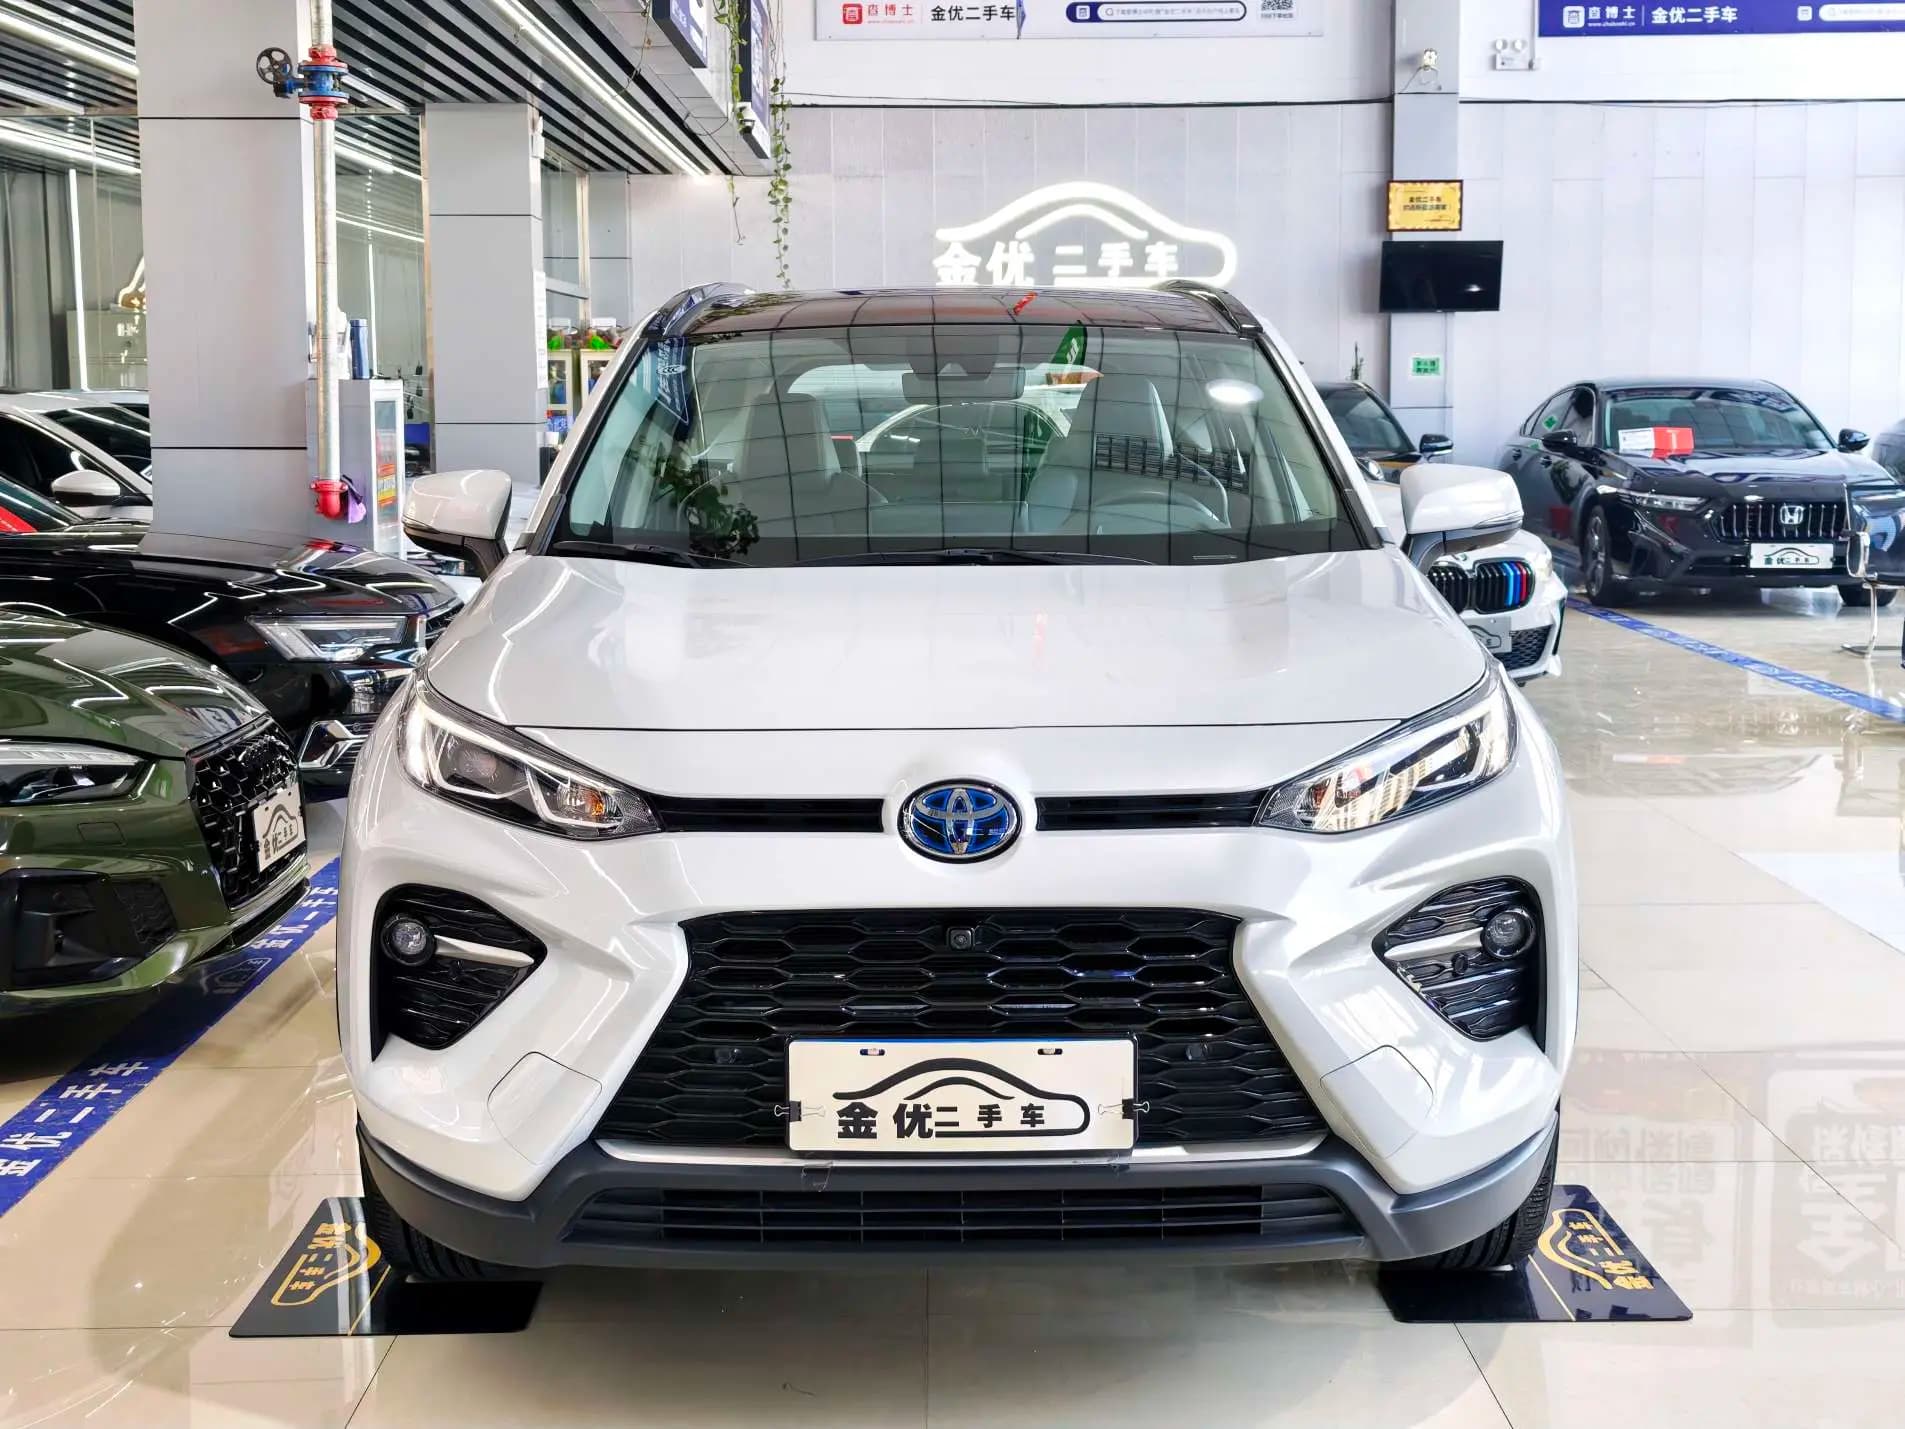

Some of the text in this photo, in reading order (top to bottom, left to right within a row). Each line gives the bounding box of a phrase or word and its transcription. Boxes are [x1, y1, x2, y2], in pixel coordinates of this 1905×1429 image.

[931, 5, 1016, 21] 金优二手车
[1651, 6, 1738, 24] 金优二手车
[932, 240, 1179, 286] 金优二手车
[263, 823, 293, 861] 金优二手车
[836, 1102, 1045, 1139] 金优二手车
